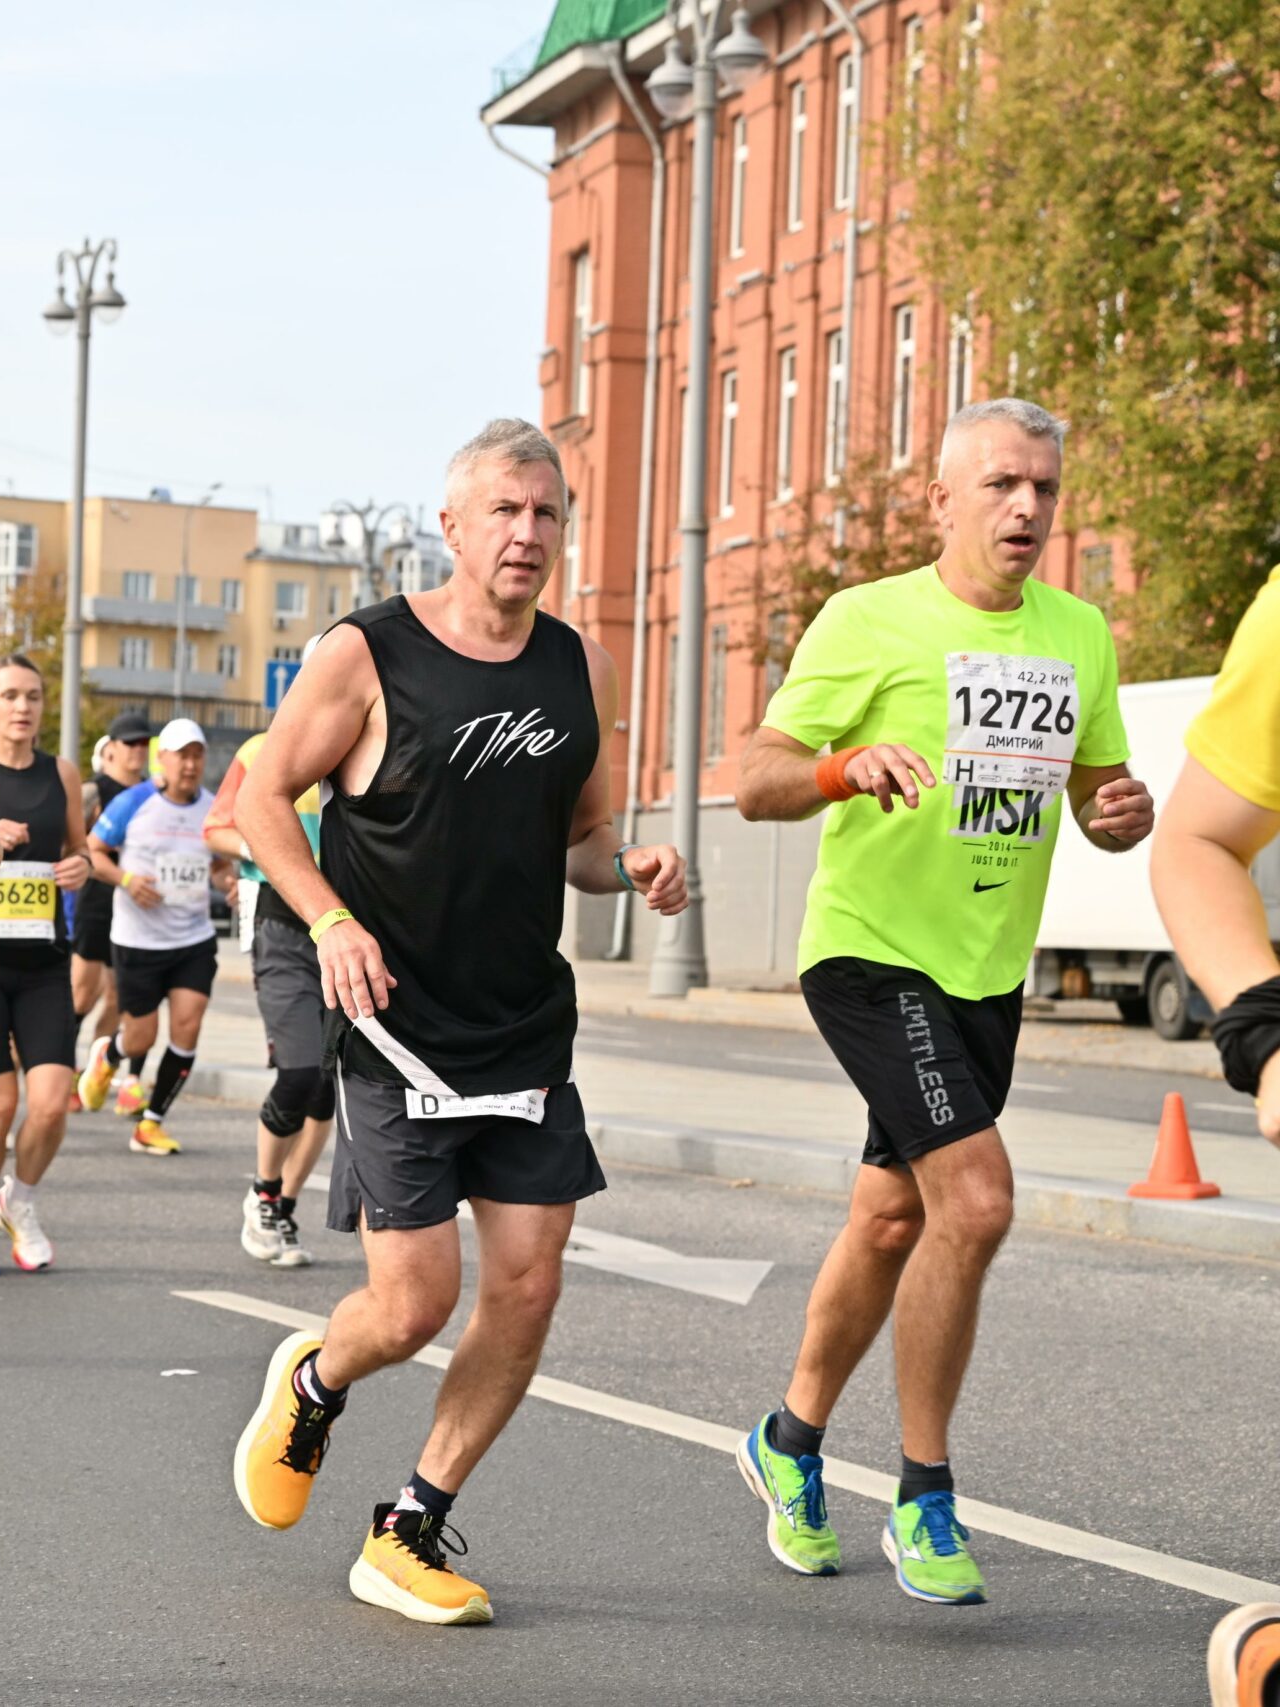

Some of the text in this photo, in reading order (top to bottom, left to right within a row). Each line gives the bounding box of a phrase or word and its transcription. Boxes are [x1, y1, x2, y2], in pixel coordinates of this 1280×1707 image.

[1018, 671, 1046, 685] 42,2
[955, 686, 1075, 735] 12726
[986, 735, 1043, 750] ДМИТРИЙ
[959, 785, 1045, 836] MSK
[988, 841, 1011, 852] 2014
[971, 855, 993, 866] JUST
[996, 857, 1008, 867] DO
[898, 991, 955, 1126] LIMITLESS
[420, 1094, 439, 1115] D
